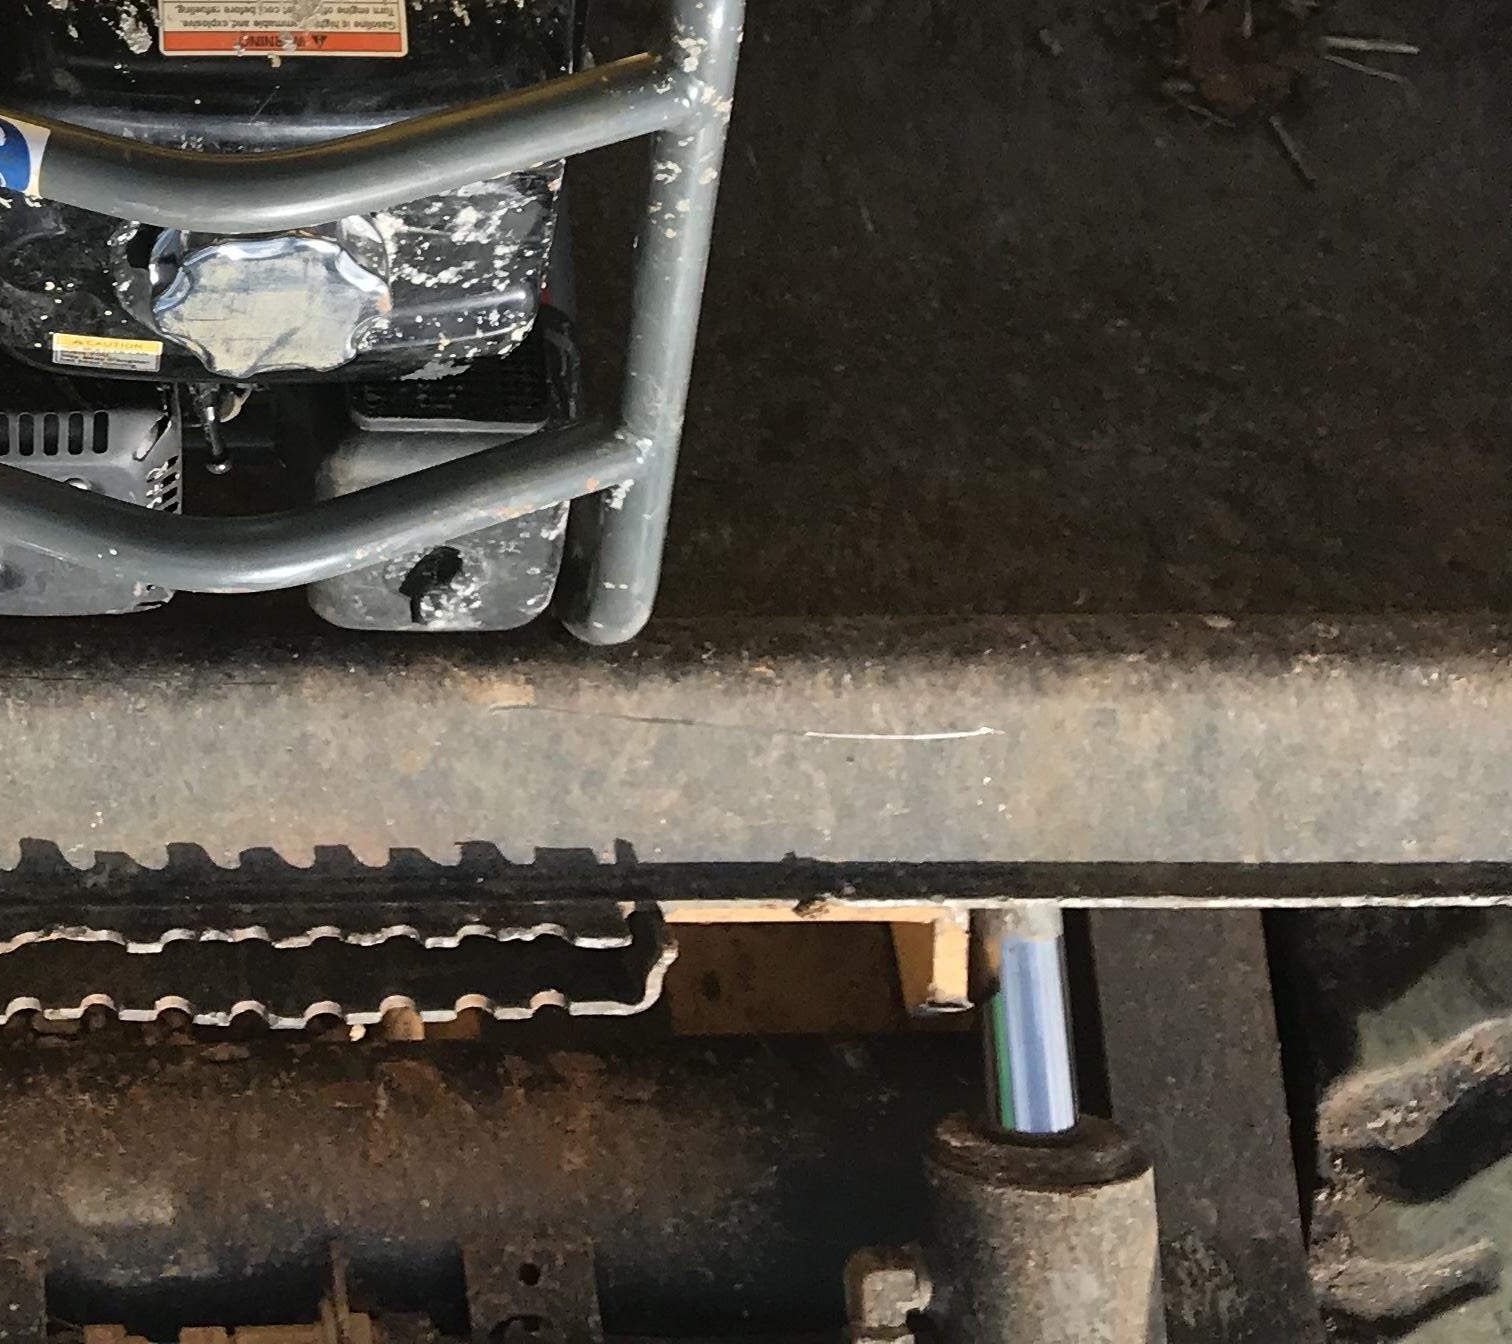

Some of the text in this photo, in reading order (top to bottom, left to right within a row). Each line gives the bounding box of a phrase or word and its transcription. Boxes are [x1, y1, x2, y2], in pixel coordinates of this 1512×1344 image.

[224, 7, 256, 15] before
[337, 6, 370, 16] engine
[373, 8, 395, 16] Turn
[231, 20, 249, 28] and
[341, 21, 350, 30] is
[354, 21, 396, 30] Gasoline
[86, 340, 144, 350] CAUTION
